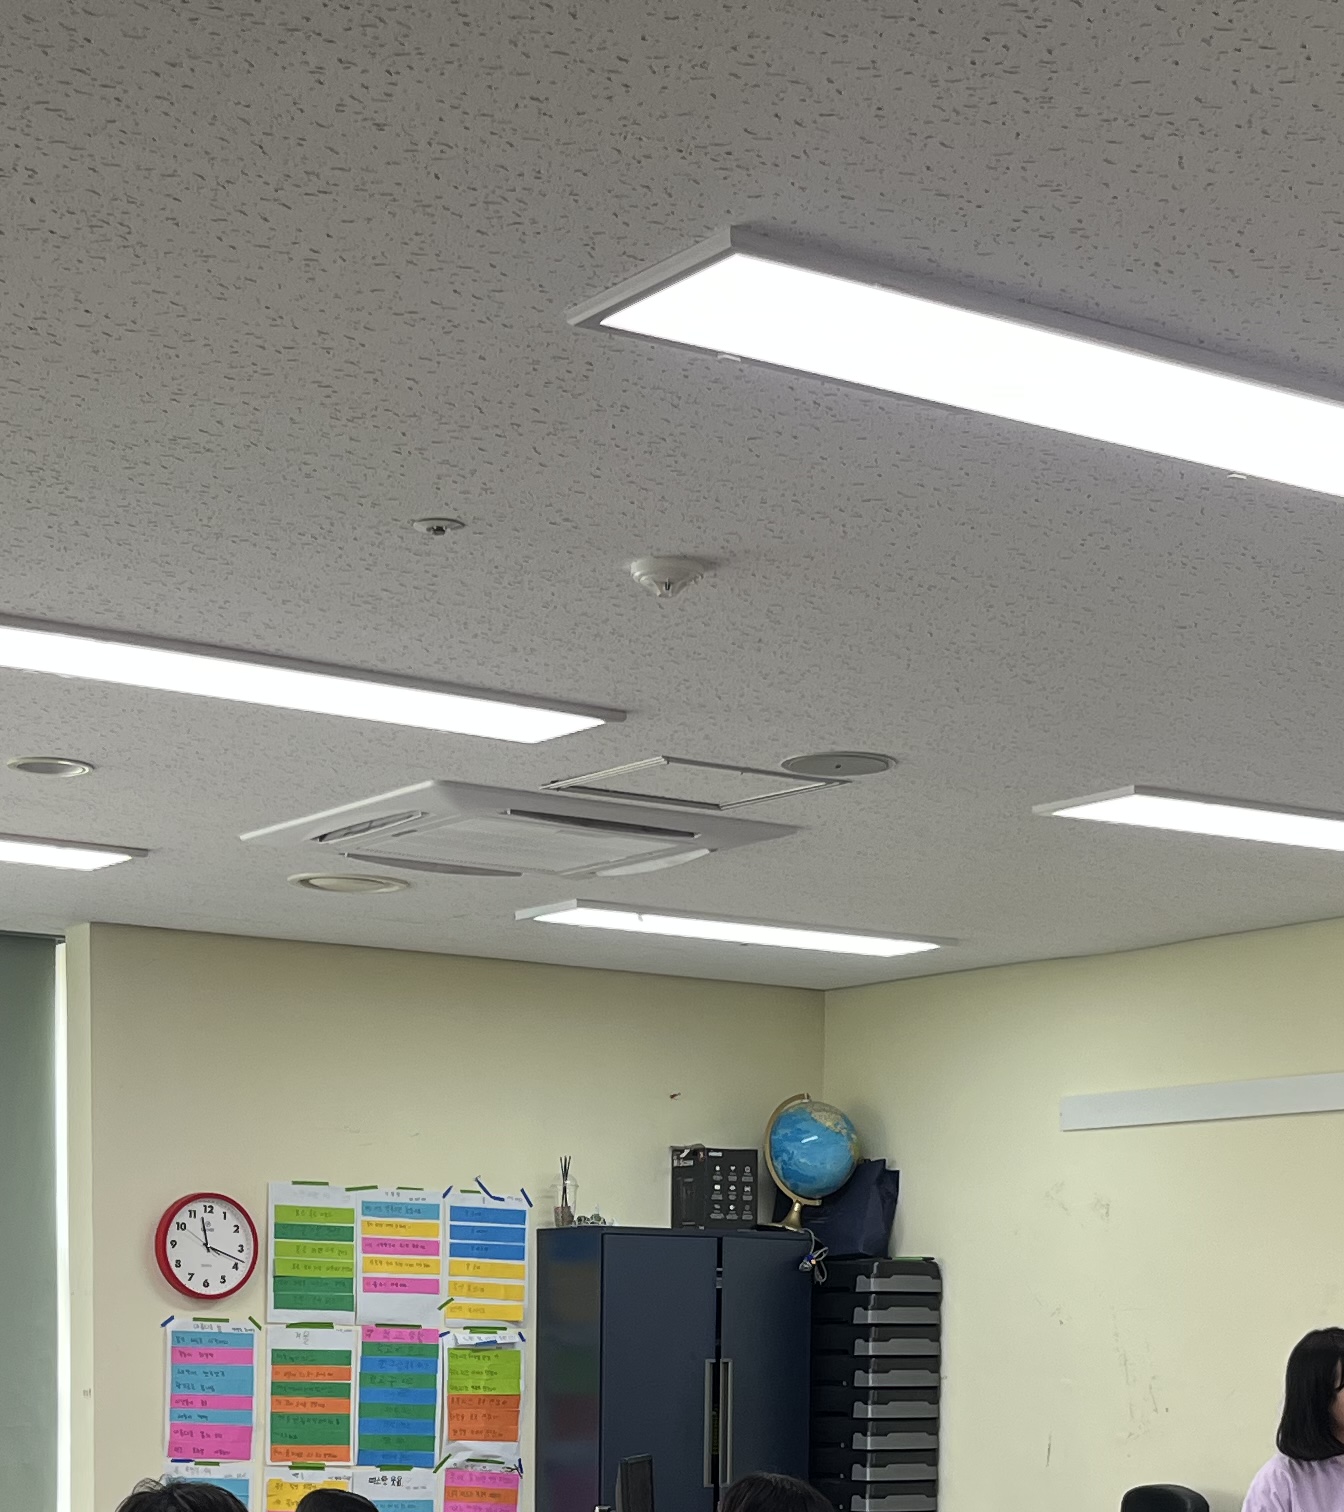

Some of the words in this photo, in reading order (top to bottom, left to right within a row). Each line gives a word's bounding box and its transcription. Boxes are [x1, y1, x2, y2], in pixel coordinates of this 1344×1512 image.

[203, 1204, 214, 1214] 12
[188, 1209, 197, 1219] 11
[222, 1211, 227, 1220] 1
[175, 1222, 187, 1231] 10
[232, 1224, 240, 1234] 2
[170, 1239, 177, 1249] 9
[237, 1244, 244, 1253] 3
[175, 1259, 181, 1268] 8
[232, 1262, 239, 1271] 4
[187, 1272, 195, 1281] 7
[219, 1275, 226, 1284] 5
[202, 1279, 210, 1288] 6
